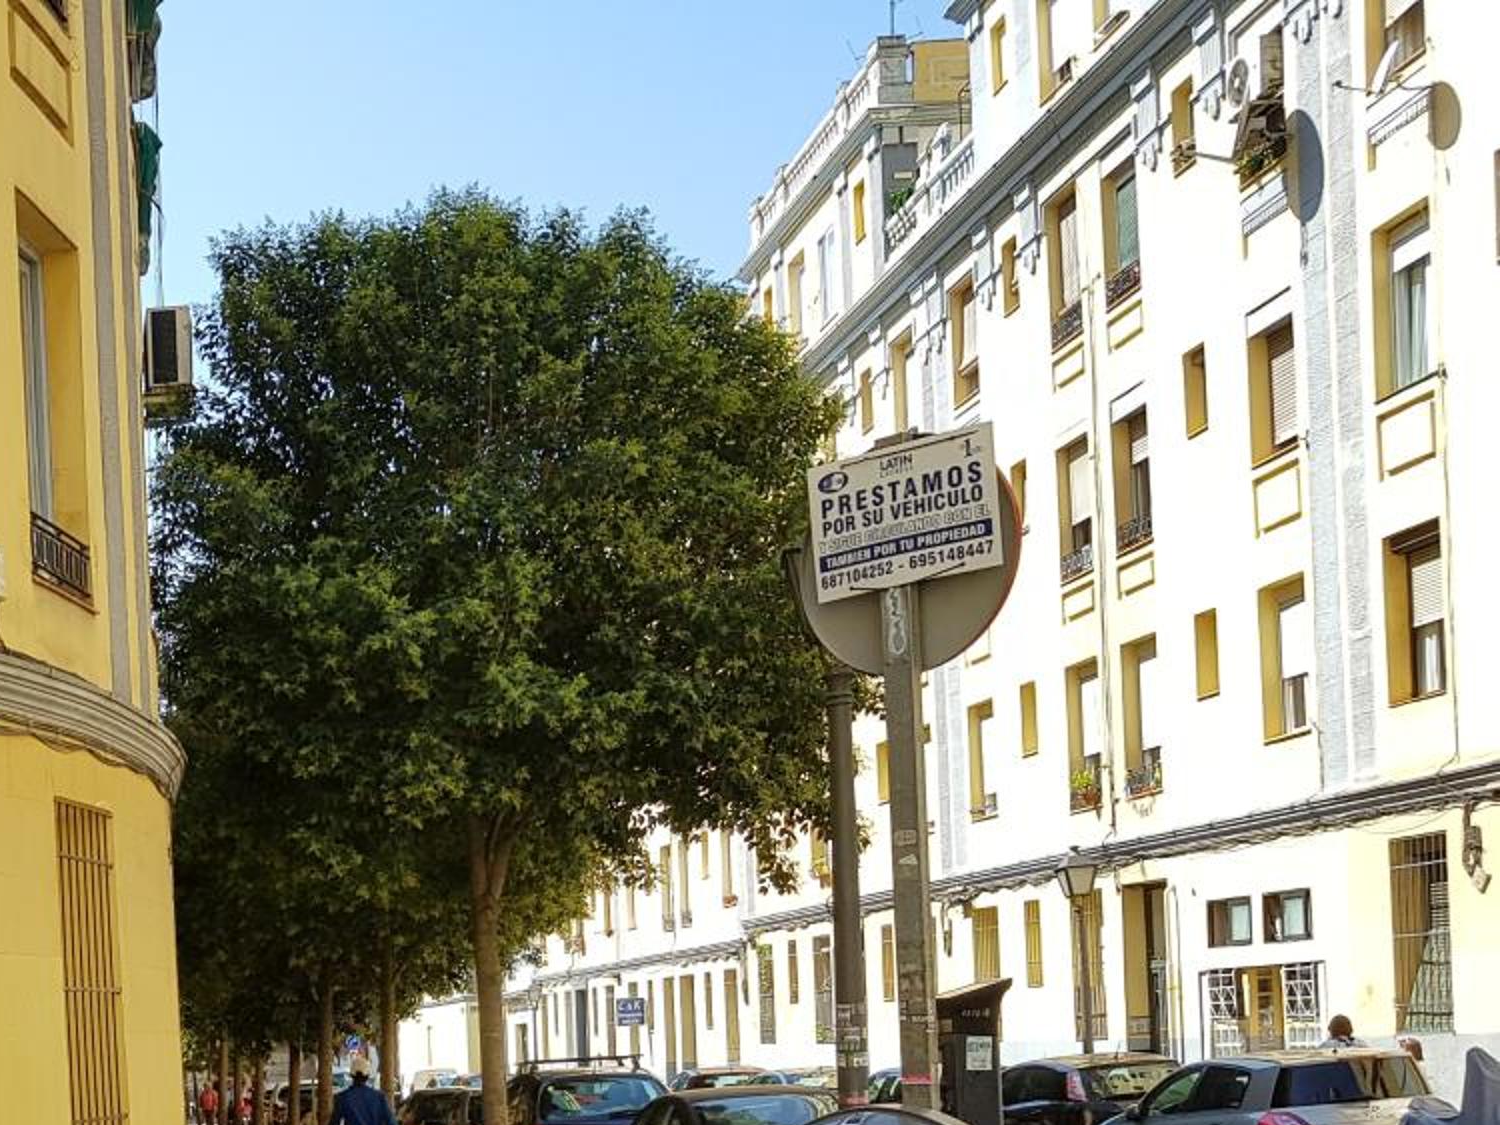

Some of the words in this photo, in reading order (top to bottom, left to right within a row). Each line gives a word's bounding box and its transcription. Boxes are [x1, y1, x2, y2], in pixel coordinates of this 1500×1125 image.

[880, 453, 913, 471] LATIN
[821, 461, 982, 519] PRESTAMOS
[823, 515, 856, 538] POR
[862, 508, 884, 527] SU
[890, 484, 983, 520] VEHICULO
[944, 507, 973, 525] CON
[975, 504, 991, 518] EL
[821, 560, 893, 590] 687104252
[909, 539, 994, 569] 695148447
[827, 547, 871, 570] TAMBIEN
[874, 541, 897, 559] POR
[901, 537, 916, 552] TU
[917, 523, 985, 547] PROPIEDAD
